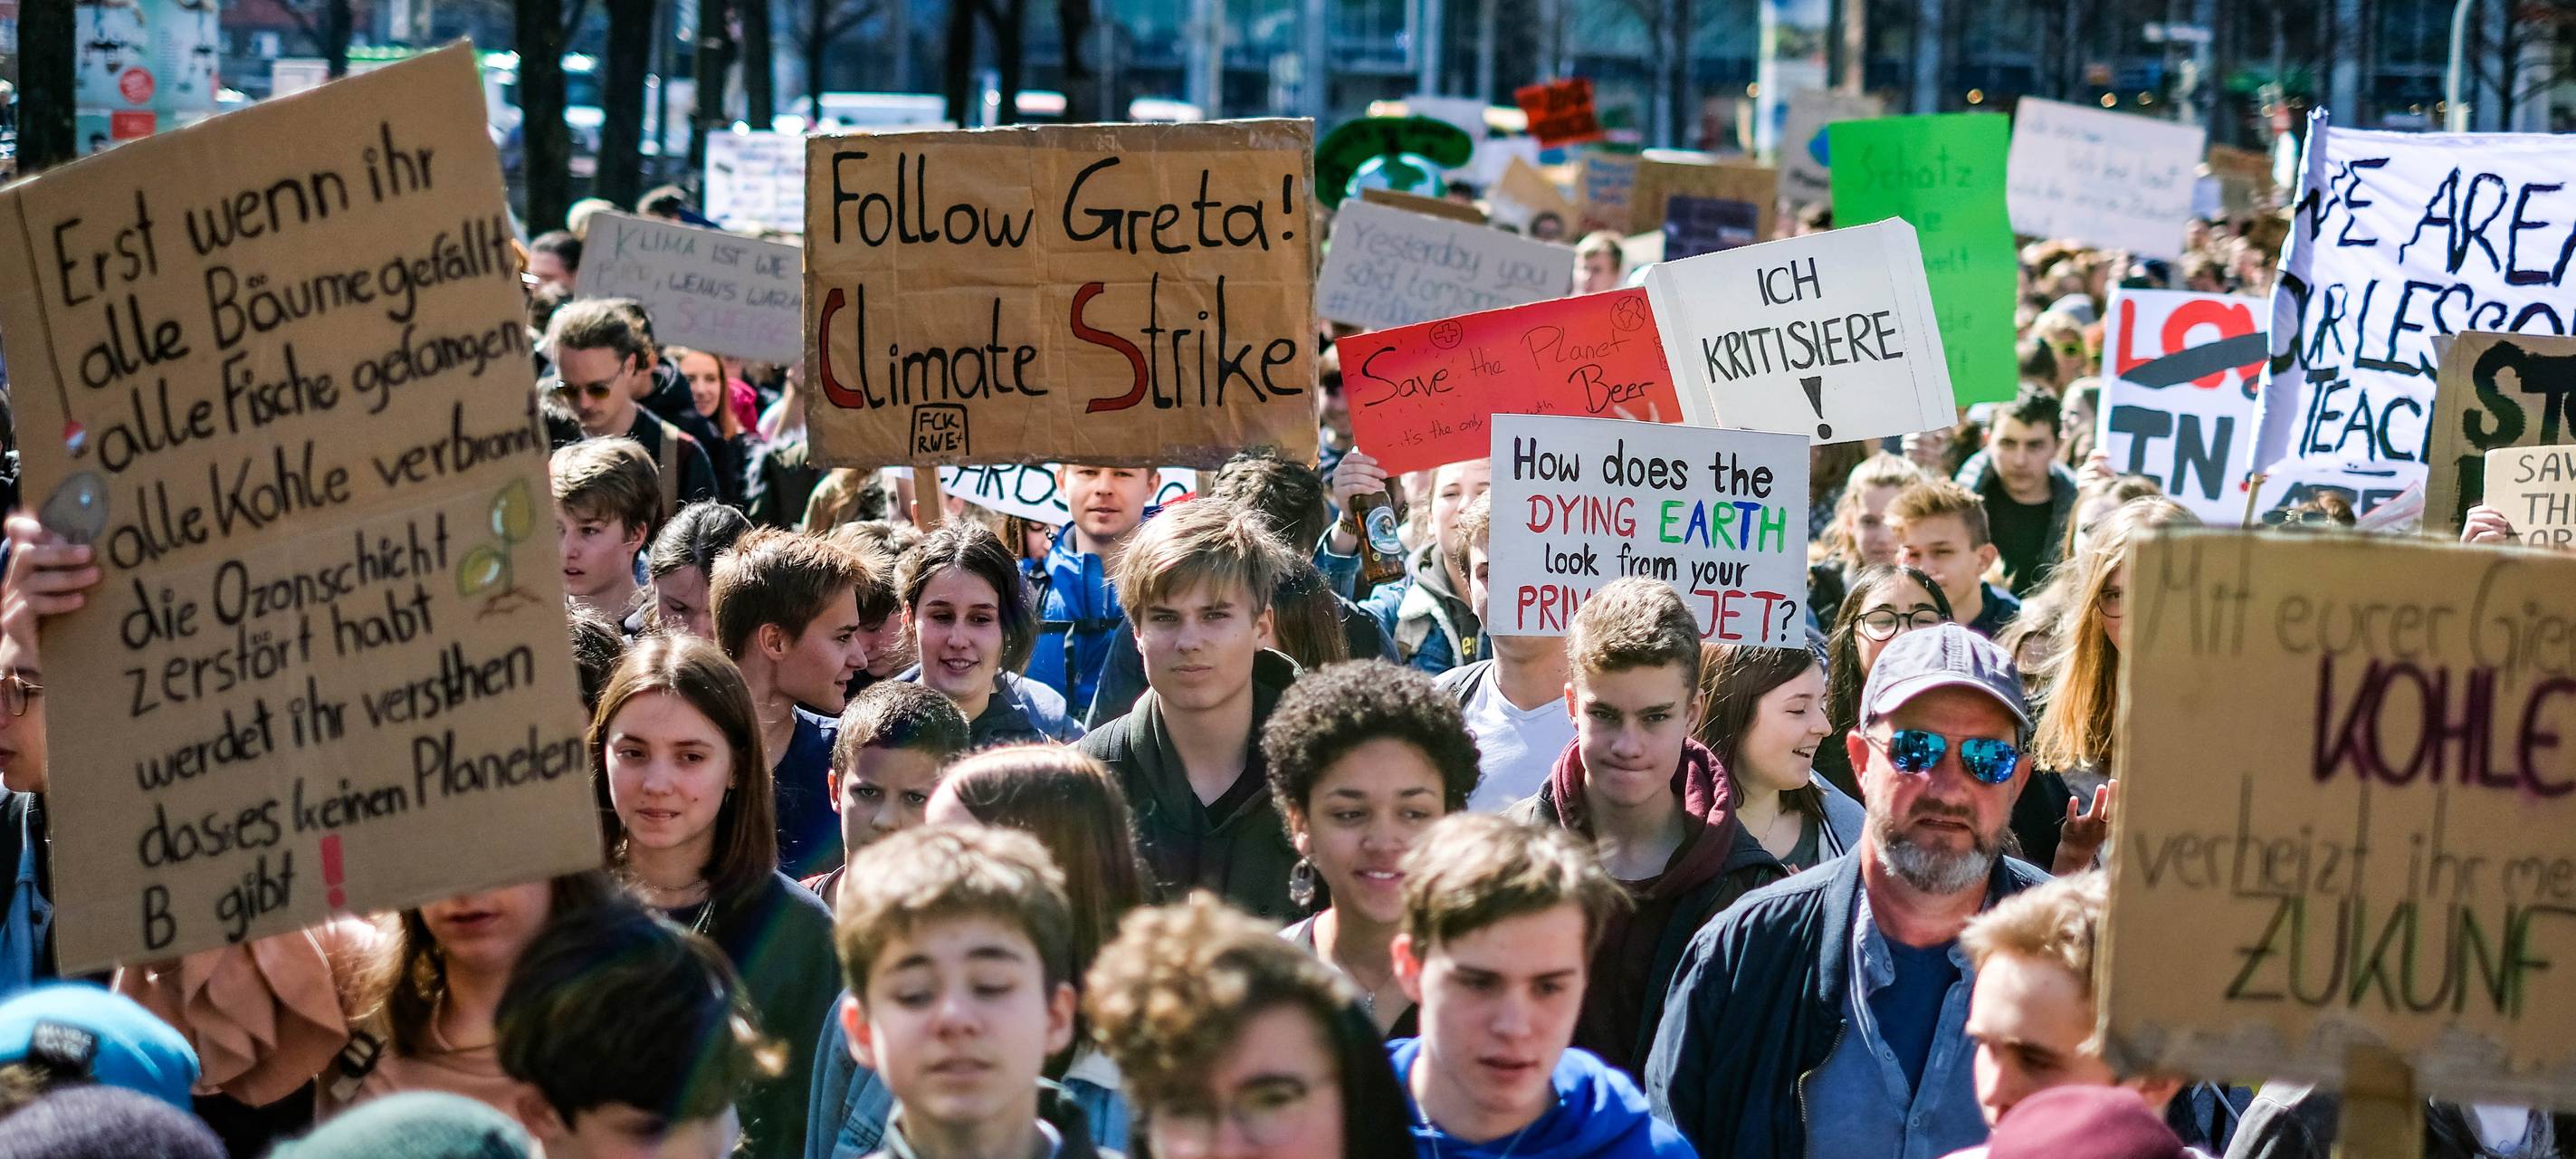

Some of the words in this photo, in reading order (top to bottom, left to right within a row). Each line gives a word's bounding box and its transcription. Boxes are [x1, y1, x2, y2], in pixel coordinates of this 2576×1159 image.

[52, 188, 158, 307] Erst
[186, 168, 349, 256] wenn
[363, 120, 434, 203] ihr
[832, 151, 1034, 247] Follow
[1063, 156, 1293, 254] Greta!
[80, 292, 191, 389] alle
[205, 265, 376, 351] Bäume
[377, 214, 513, 323] gefällt
[1496, 258, 1549, 290] you
[1757, 257, 1821, 306] ICH
[819, 283, 1048, 408] Climate
[1070, 271, 1303, 414] Strike
[1361, 346, 1454, 407] Save
[1468, 347, 1505, 377] the
[1521, 325, 1631, 371] Planet
[1568, 363, 1655, 414] Beer
[1703, 311, 1903, 383] KRITISIERE
[98, 377, 216, 474] alle
[222, 340, 340, 434] Fische
[351, 320, 527, 415] gefangen
[919, 412, 960, 433] FCK
[1429, 419, 1454, 439] the
[1459, 413, 1484, 432] only
[1799, 375, 1833, 439] !
[2463, 340, 2576, 450] ST
[1513, 436, 1579, 483] How
[1602, 438, 1689, 491] does
[1708, 451, 1774, 499] the
[2108, 405, 2235, 502] IN
[108, 478, 212, 570] alle
[209, 441, 351, 538] Kohle
[1526, 494, 1637, 539] DYING
[1659, 499, 1787, 553] EARTH
[2521, 493, 2576, 525] TH
[120, 577, 199, 650] die
[213, 512, 450, 626] Ozonschicht
[1517, 585, 1592, 632] PRIV
[1693, 589, 1798, 643] JET?
[1545, 542, 1600, 577] look
[1617, 541, 1677, 581] from
[1689, 560, 1751, 594] your
[2140, 536, 2256, 657] Mit
[2275, 591, 2457, 660] eurer
[2469, 558, 2576, 695] Gie
[329, 581, 433, 658] habt
[137, 697, 275, 792] werdet
[287, 675, 348, 749] ihr
[2314, 652, 2576, 800] KOHLE
[292, 776, 408, 834] keinen
[412, 724, 586, 809] Planeten
[2135, 771, 2369, 899] verheizt
[2408, 783, 2486, 900] ihr
[143, 884, 177, 952] B
[216, 848, 296, 943] gibt
